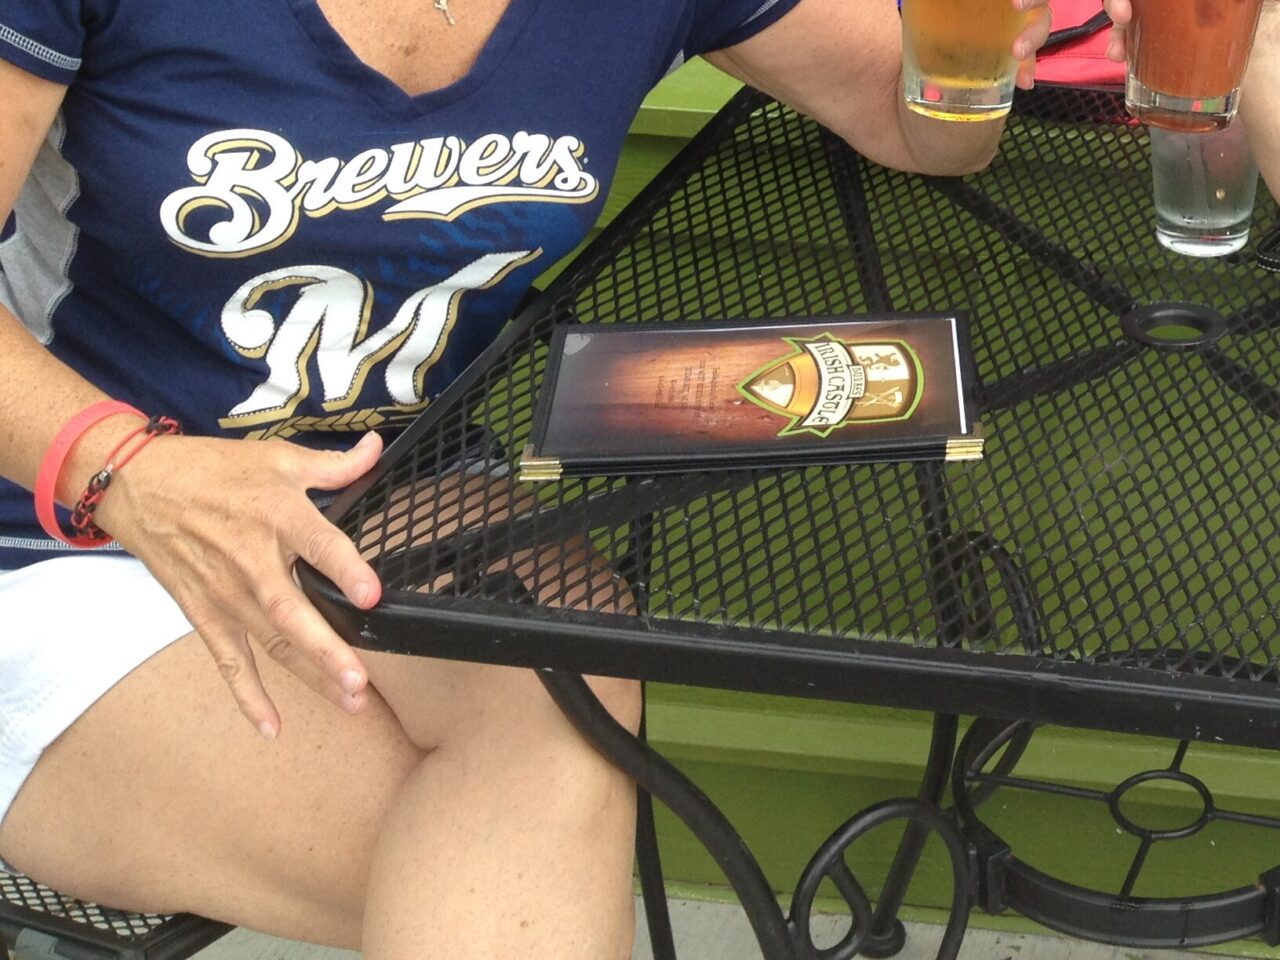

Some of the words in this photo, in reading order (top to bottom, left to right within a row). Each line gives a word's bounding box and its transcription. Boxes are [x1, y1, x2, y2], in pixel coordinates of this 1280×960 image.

[160, 128, 599, 258] Brewers
[217, 246, 543, 428] M
[814, 343, 845, 375] IRISH
[812, 376, 845, 426] CASTLE
